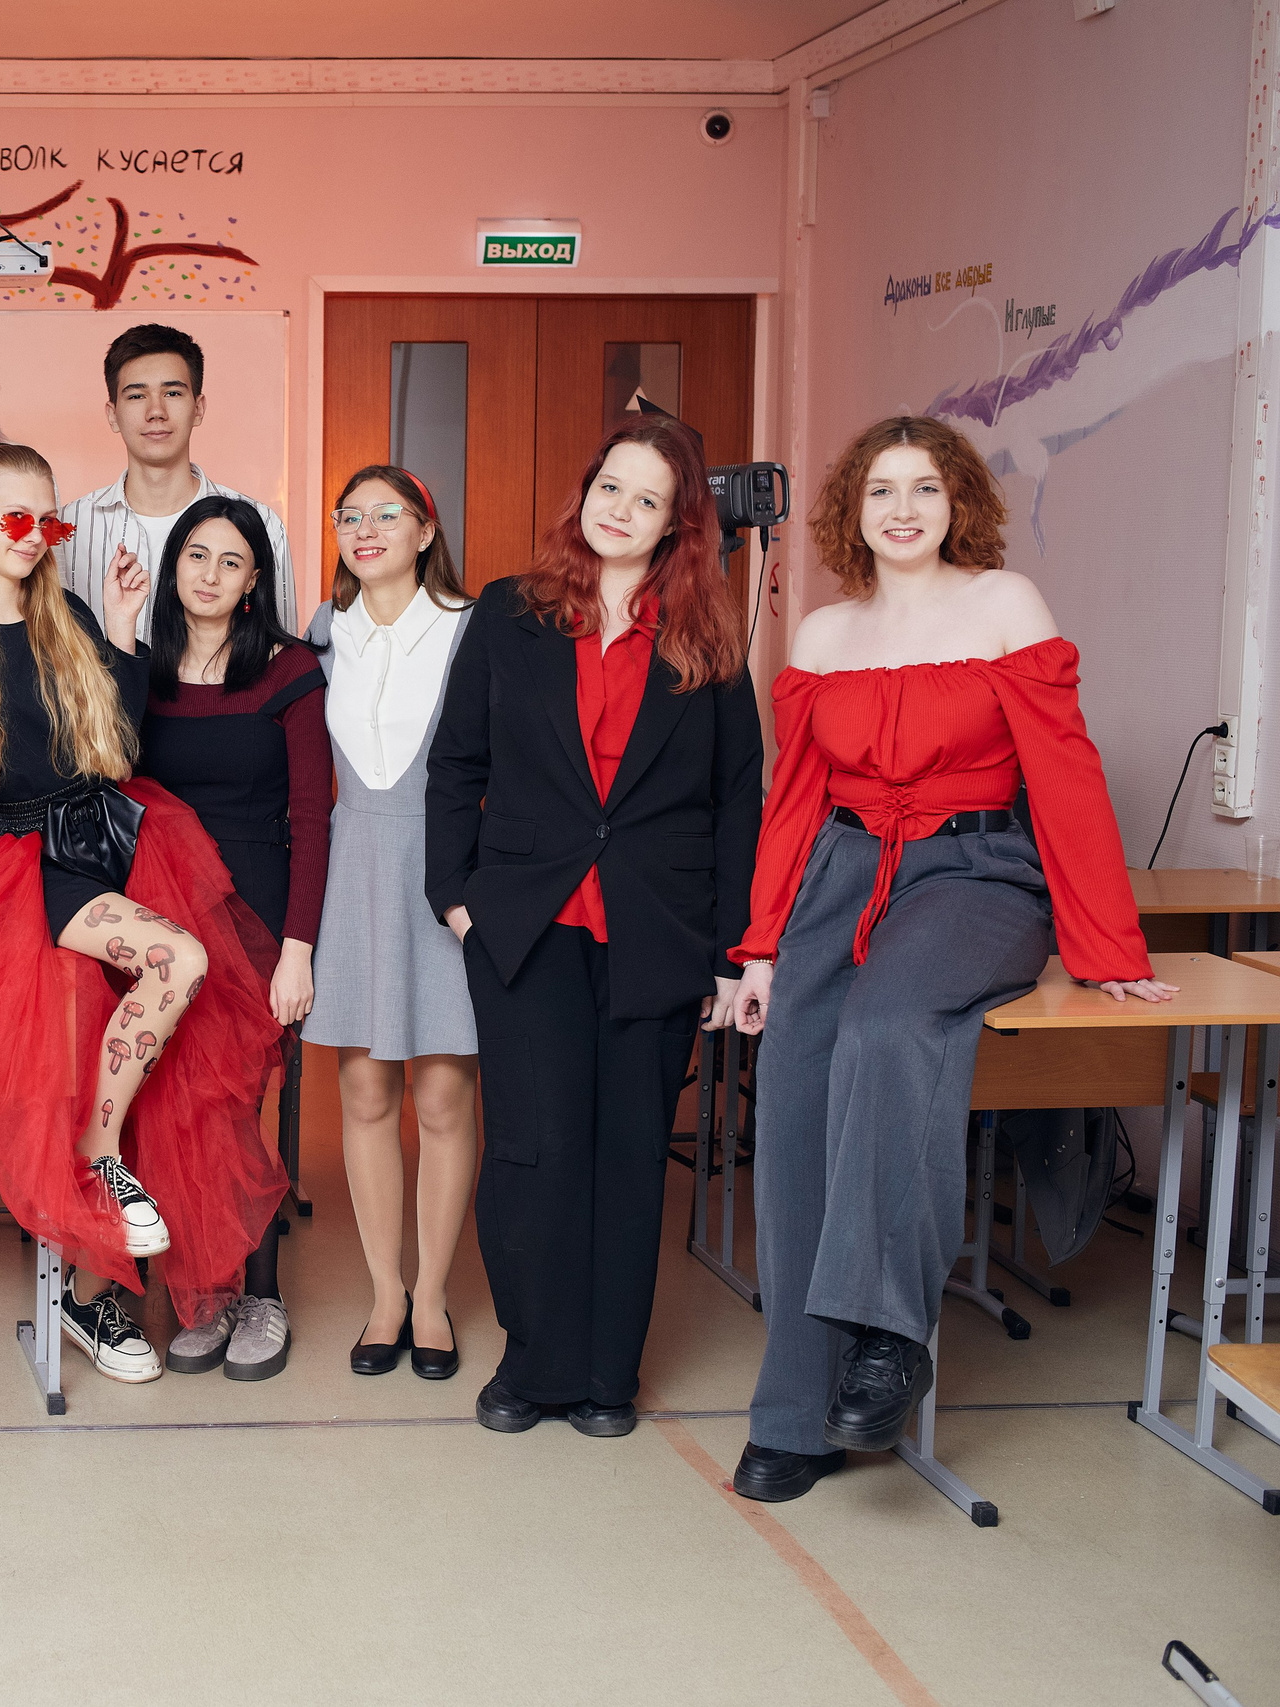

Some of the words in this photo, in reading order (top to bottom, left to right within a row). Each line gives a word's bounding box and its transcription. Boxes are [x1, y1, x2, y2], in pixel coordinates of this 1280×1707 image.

[0, 144, 68, 172] волк
[97, 148, 244, 175] кусается
[486, 243, 571, 261] ВЫХОД
